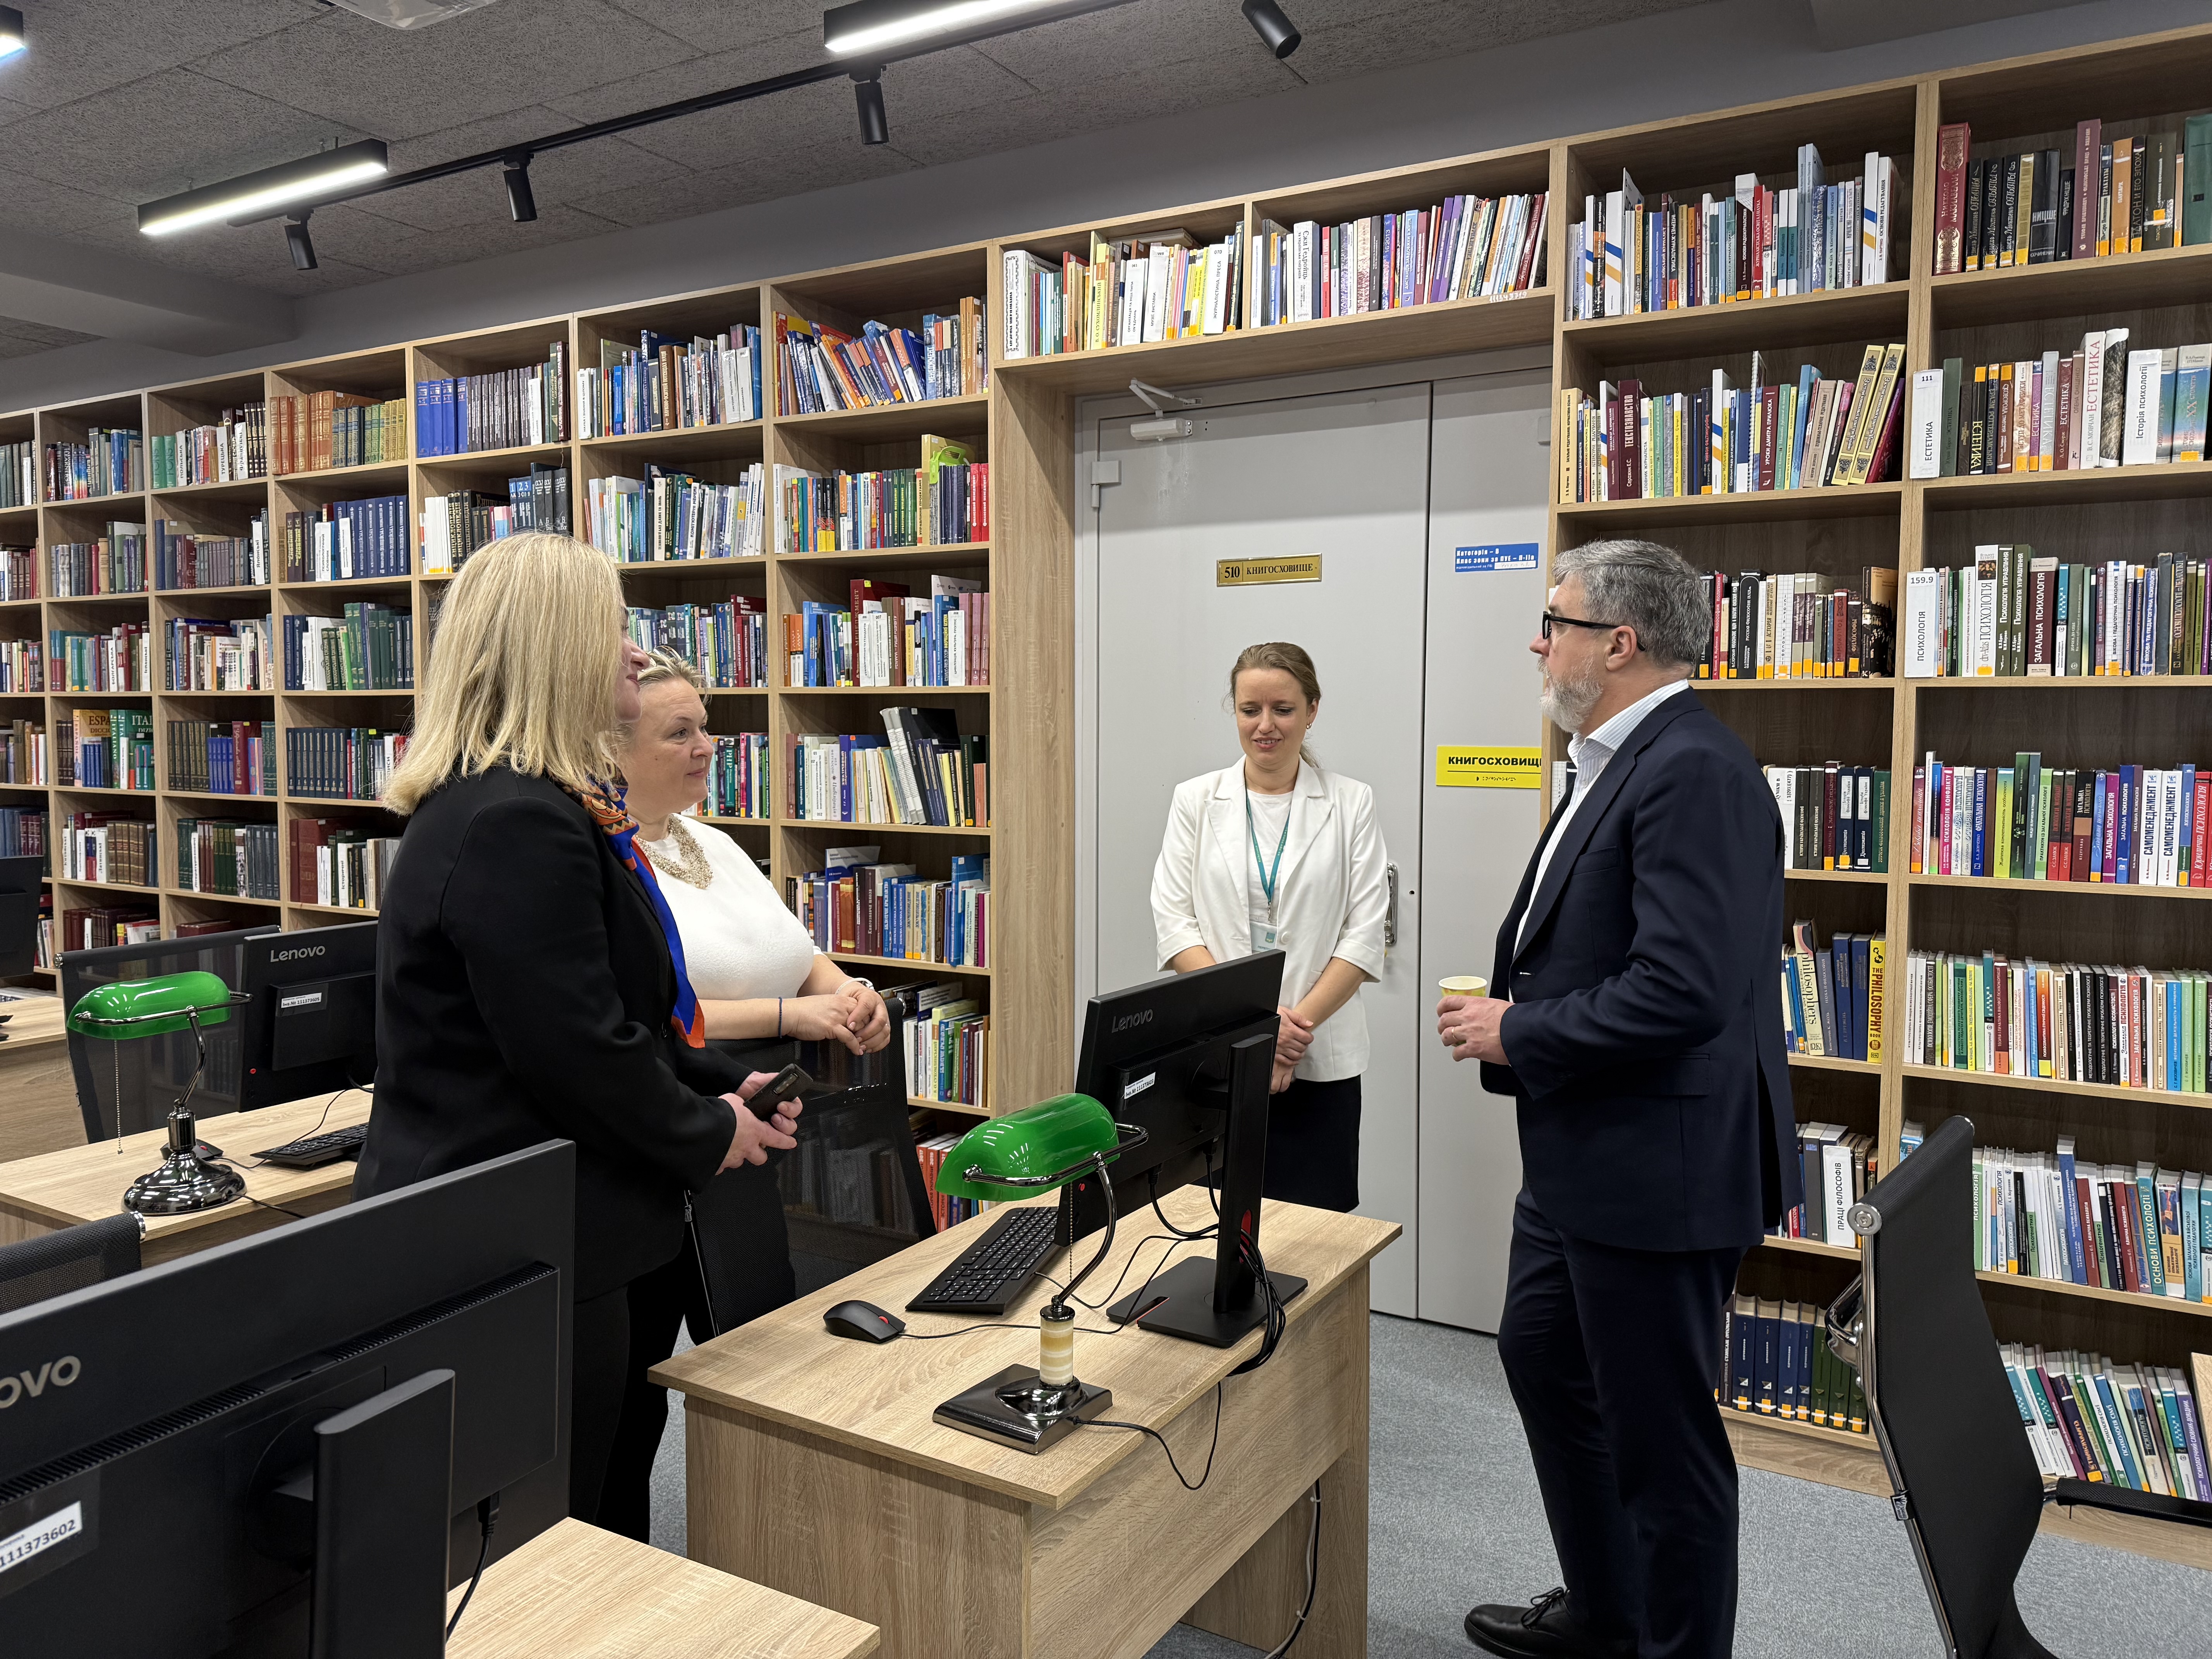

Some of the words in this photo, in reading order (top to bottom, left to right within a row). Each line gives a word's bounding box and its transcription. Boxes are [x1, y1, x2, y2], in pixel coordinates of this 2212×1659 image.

[2032, 210, 2057, 222] НИЦШЕ
[2139, 366, 2148, 409] психології
[1624, 395, 1634, 448] ТЕКСТОЗНАВСТВО
[2032, 402, 2040, 436] ЕСТЕТИКА
[2135, 411, 2146, 439] Історія
[1972, 421, 1983, 468] ЕСТЕТИКА
[510, 483, 515, 492] 1
[524, 481, 529, 489] 3
[1224, 566, 1240, 579] 510
[1246, 563, 1313, 575] КНИГОСХОВИЩЕ
[1910, 576, 1934, 584] 159.9
[2035, 573, 2046, 620] ПСИХОЛОГІЯ
[1917, 611, 1926, 661] ПСИХОЛОГІЯ
[2034, 624, 2044, 663] ЗАГАЛЬНА
[1448, 756, 1542, 768] КНИГОСХОВИЩ
[2107, 792, 2115, 828] ПСИХОЛОГІЯ
[2143, 785, 2157, 855] САМОМЕНЕДЖМЕНТ
[2163, 785, 2177, 856] САМОМЕНЕДЖМЕНТ
[2196, 785, 2207, 834] ПСИХОЛОГІЯ
[2106, 829, 2114, 859] ЗАГАЛЬНА
[2194, 835, 2203, 870] Юридична
[270, 946, 326, 962] Lenovo
[1797, 952, 1817, 1025] philosophers
[1870, 973, 1883, 1034] PHILOSOPHY
[1111, 1008, 1153, 1033] Lenovo
[1834, 1162, 1843, 1206] ФІЛОСОФІВ
[1837, 1207, 1845, 1230] ПРАЦІ
[2141, 1195, 2157, 1245] ПСИХОЛОГІЇ
[2096, 1224, 2105, 1263] Психогенетика
[2150, 1248, 2162, 1284] ОСНОВИ
[2113, 1420, 2128, 1456] ПСИХОЛОГІЯ
